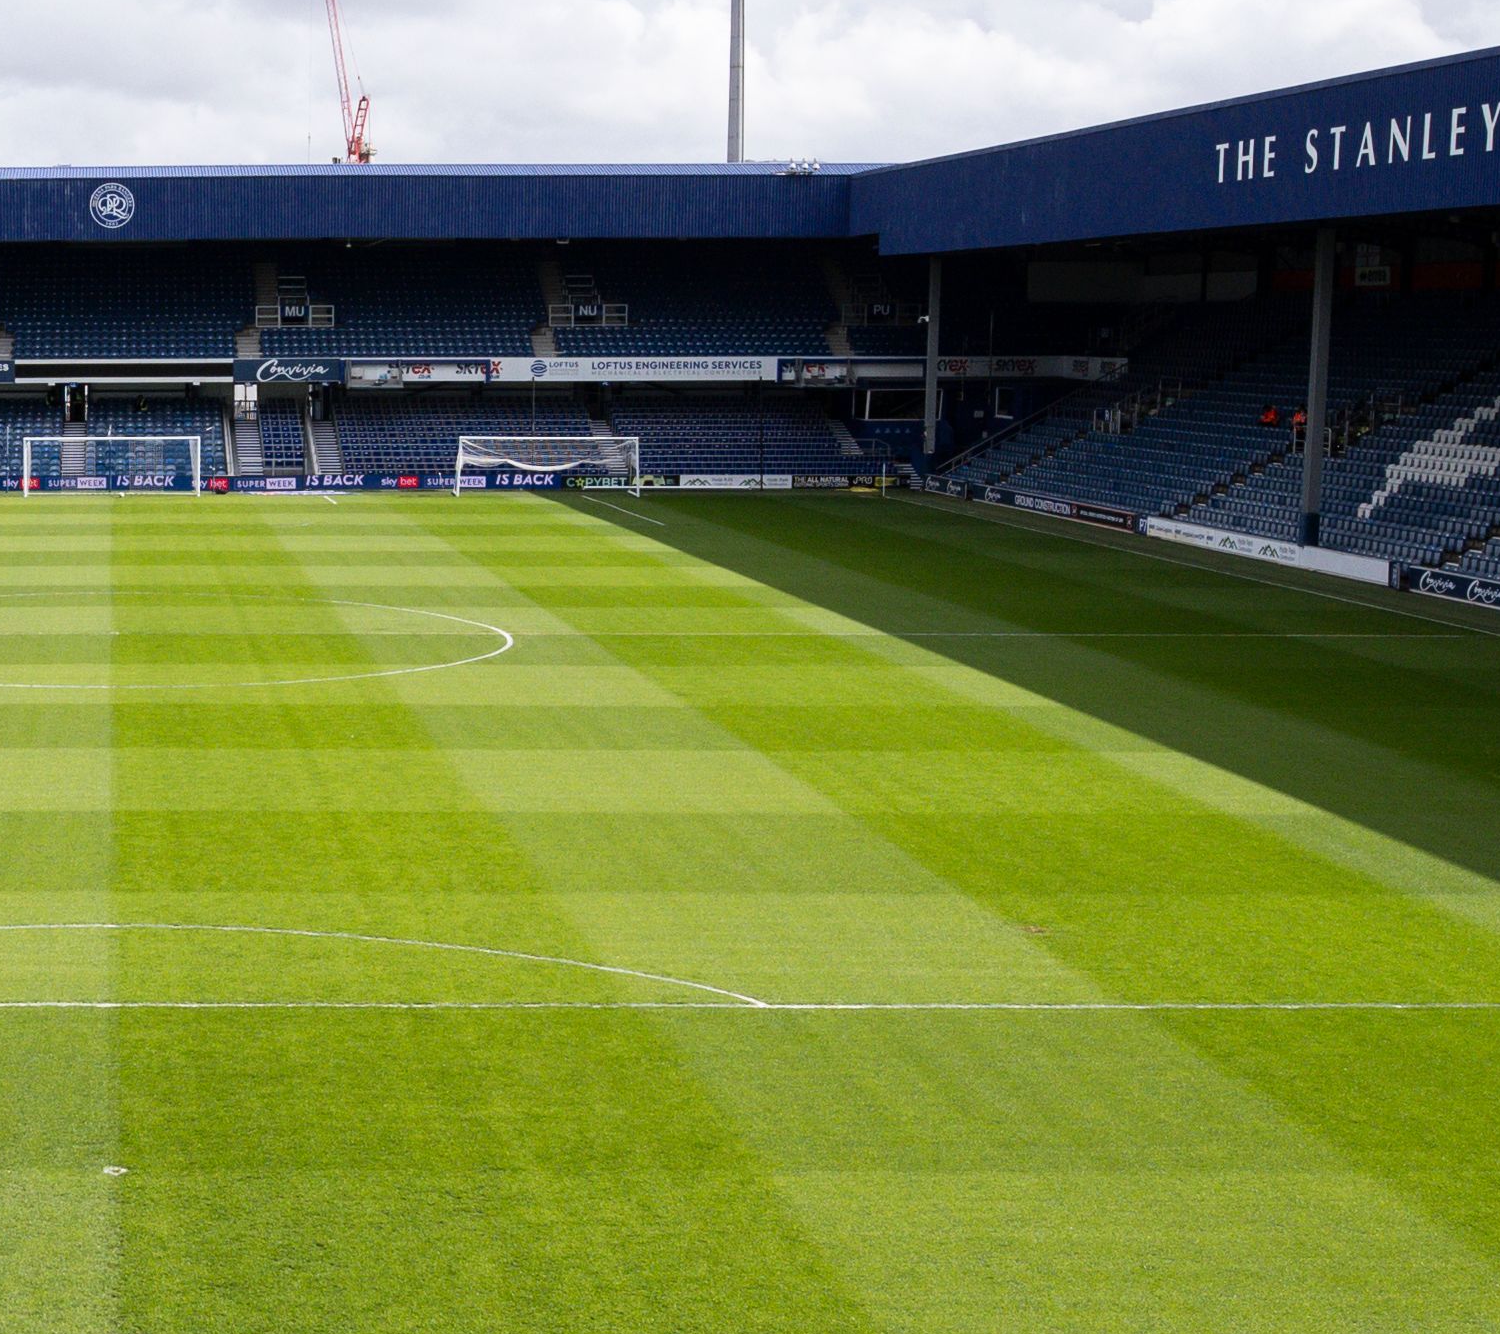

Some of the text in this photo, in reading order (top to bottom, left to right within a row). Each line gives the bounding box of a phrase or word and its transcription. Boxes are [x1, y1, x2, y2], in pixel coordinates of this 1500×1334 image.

[1216, 136, 1276, 184] THE
[285, 306, 305, 317] MU
[579, 305, 597, 316] NU
[873, 305, 890, 316] PU
[256, 359, 330, 382] Convivia
[591, 360, 762, 370] LOFTUS ENGINEERING SERVICES
[381, 477, 397, 488] sky
[400, 477, 418, 487] bet
[427, 477, 455, 487] SUPER
[495, 474, 509, 485] IS
[512, 474, 554, 485] BACK
[1015, 494, 1071, 515] GROUND CONSTRUCTION
[1419, 570, 1456, 594] Convivia
